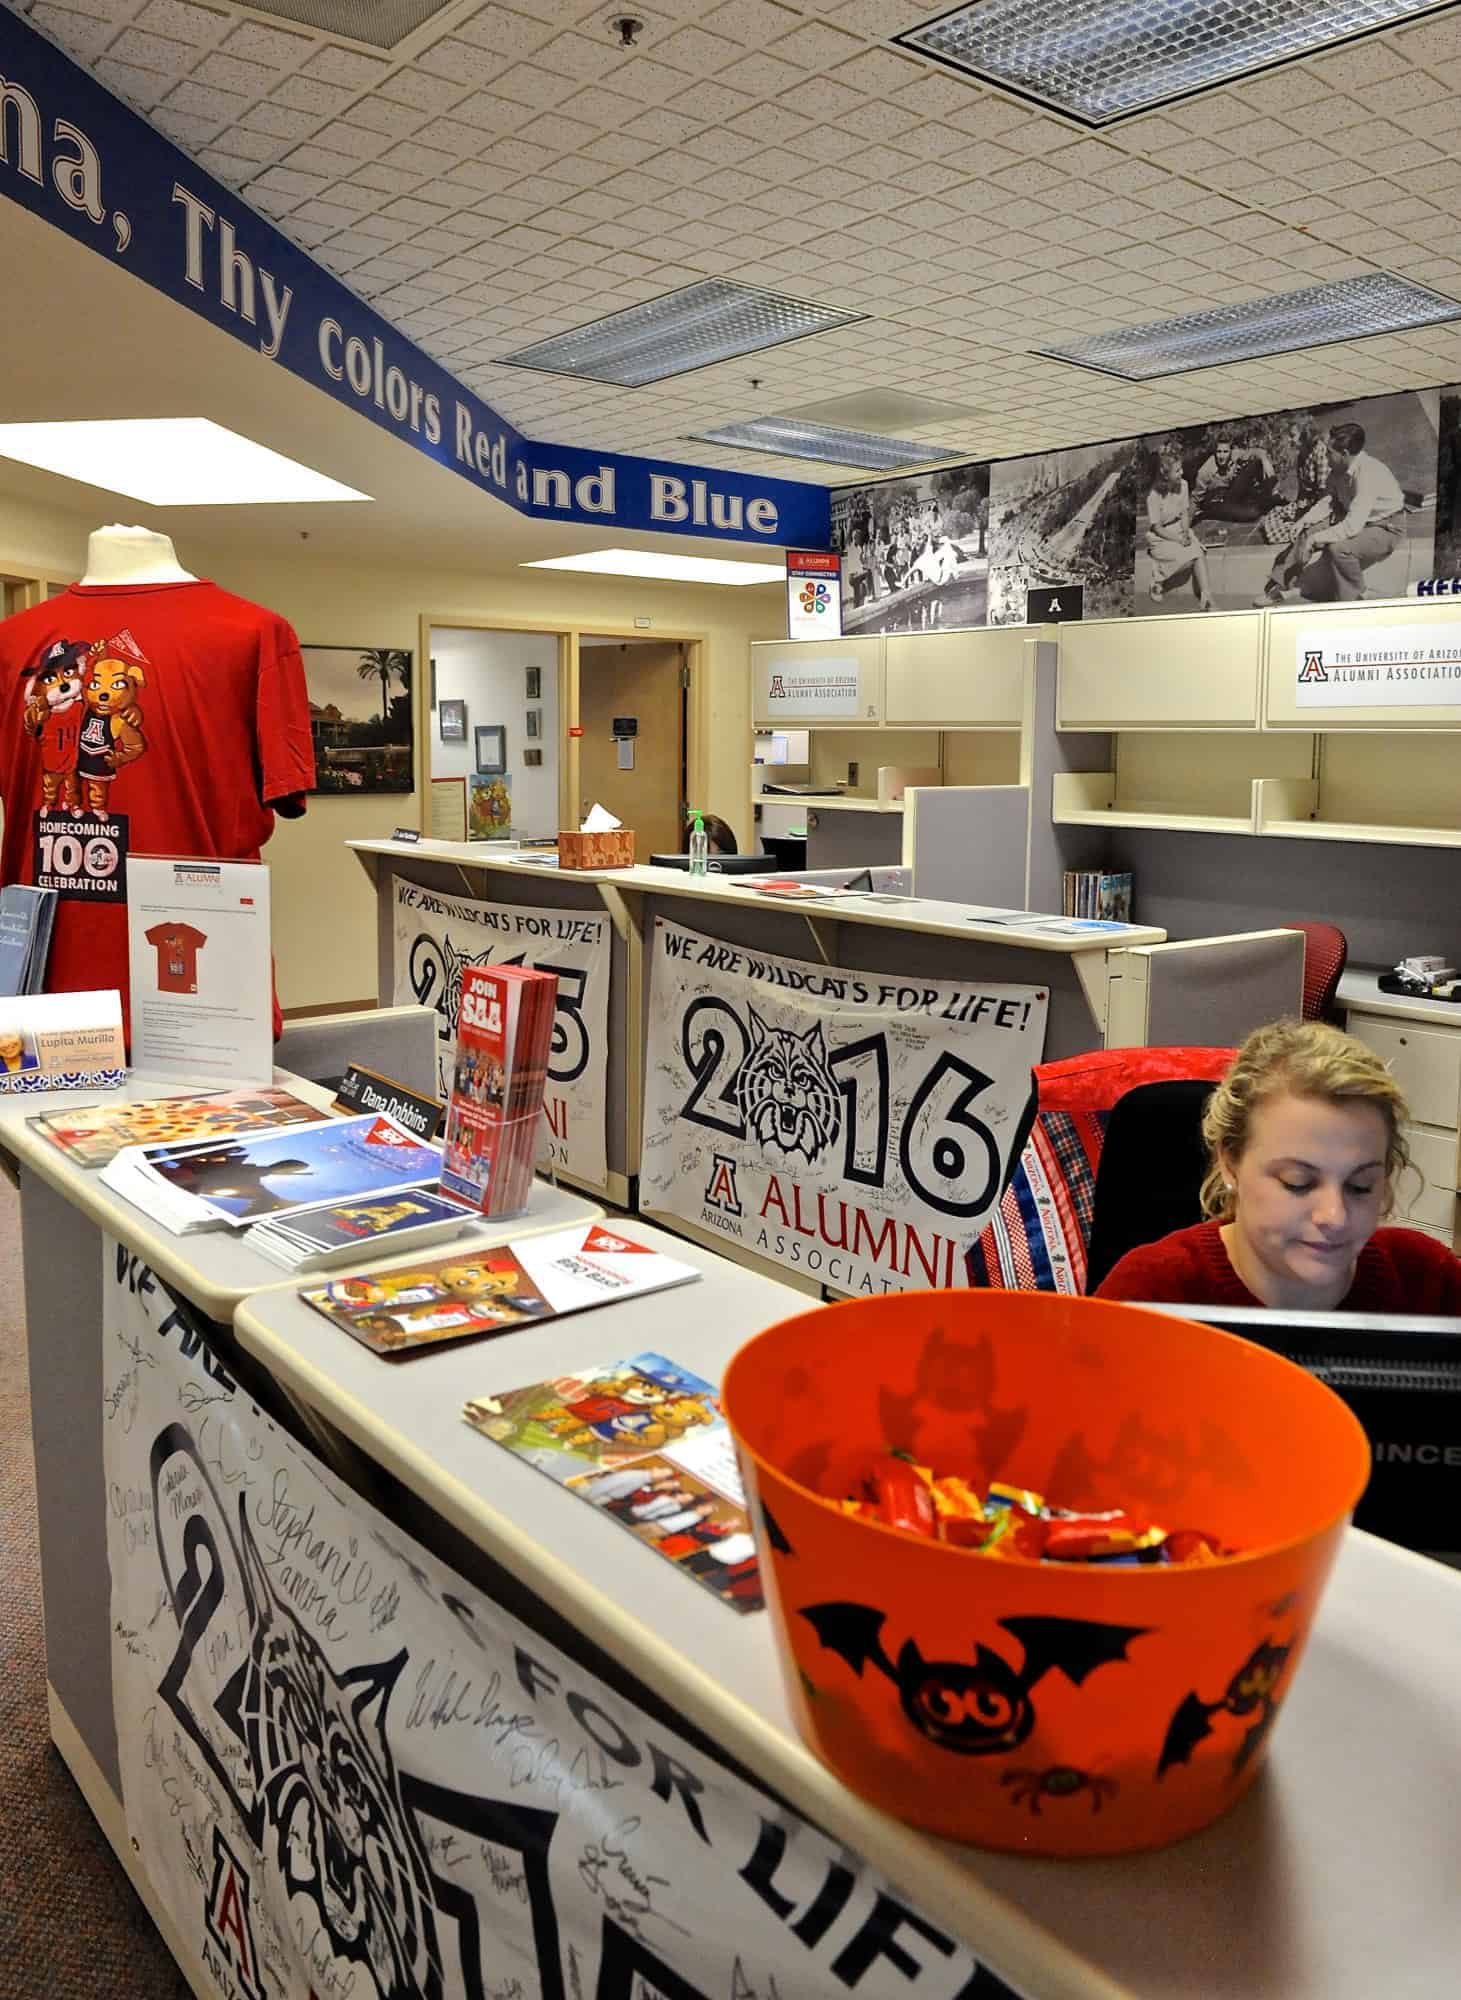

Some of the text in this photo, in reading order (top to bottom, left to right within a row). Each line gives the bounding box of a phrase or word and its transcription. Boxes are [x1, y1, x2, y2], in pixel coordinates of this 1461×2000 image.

[171, 181, 293, 360] Thy
[455, 399, 507, 490] Red
[516, 459, 616, 516] and
[649, 472, 779, 535] Blue
[1047, 597, 1064, 613] A
[1298, 650, 1329, 683] A
[1355, 651, 1409, 663] UNIVERSITY
[1413, 650, 1425, 660] OF
[1333, 668, 1380, 682] ALUMNI
[769, 675, 785, 698] A
[787, 687, 857, 698] ALUMNI ASSOCIATION
[81, 717, 105, 746] A
[39, 821, 120, 838] HOMECOMING
[39, 835, 119, 878] 100
[38, 874, 118, 892] CELEBRATION
[399, 887, 603, 945] WE ARE WILDCATS FOR LIFE!
[469, 976, 498, 999] JOIN
[664, 932, 1032, 1033] WE ARE WILDCATS FOR LIFE!
[40, 1033, 115, 1048] Lupita Murillo
[361, 1085, 387, 1113] Dana
[387, 1097, 429, 1133] Dobbins
[704, 1153, 743, 1217] A
[700, 1207, 744, 1238] ARIZONA
[759, 1173, 957, 1289] ALUMNI
[555, 1257, 589, 1275] BBQ
[586, 1272, 621, 1288] Bash
[512, 1643, 713, 1848] FOR
